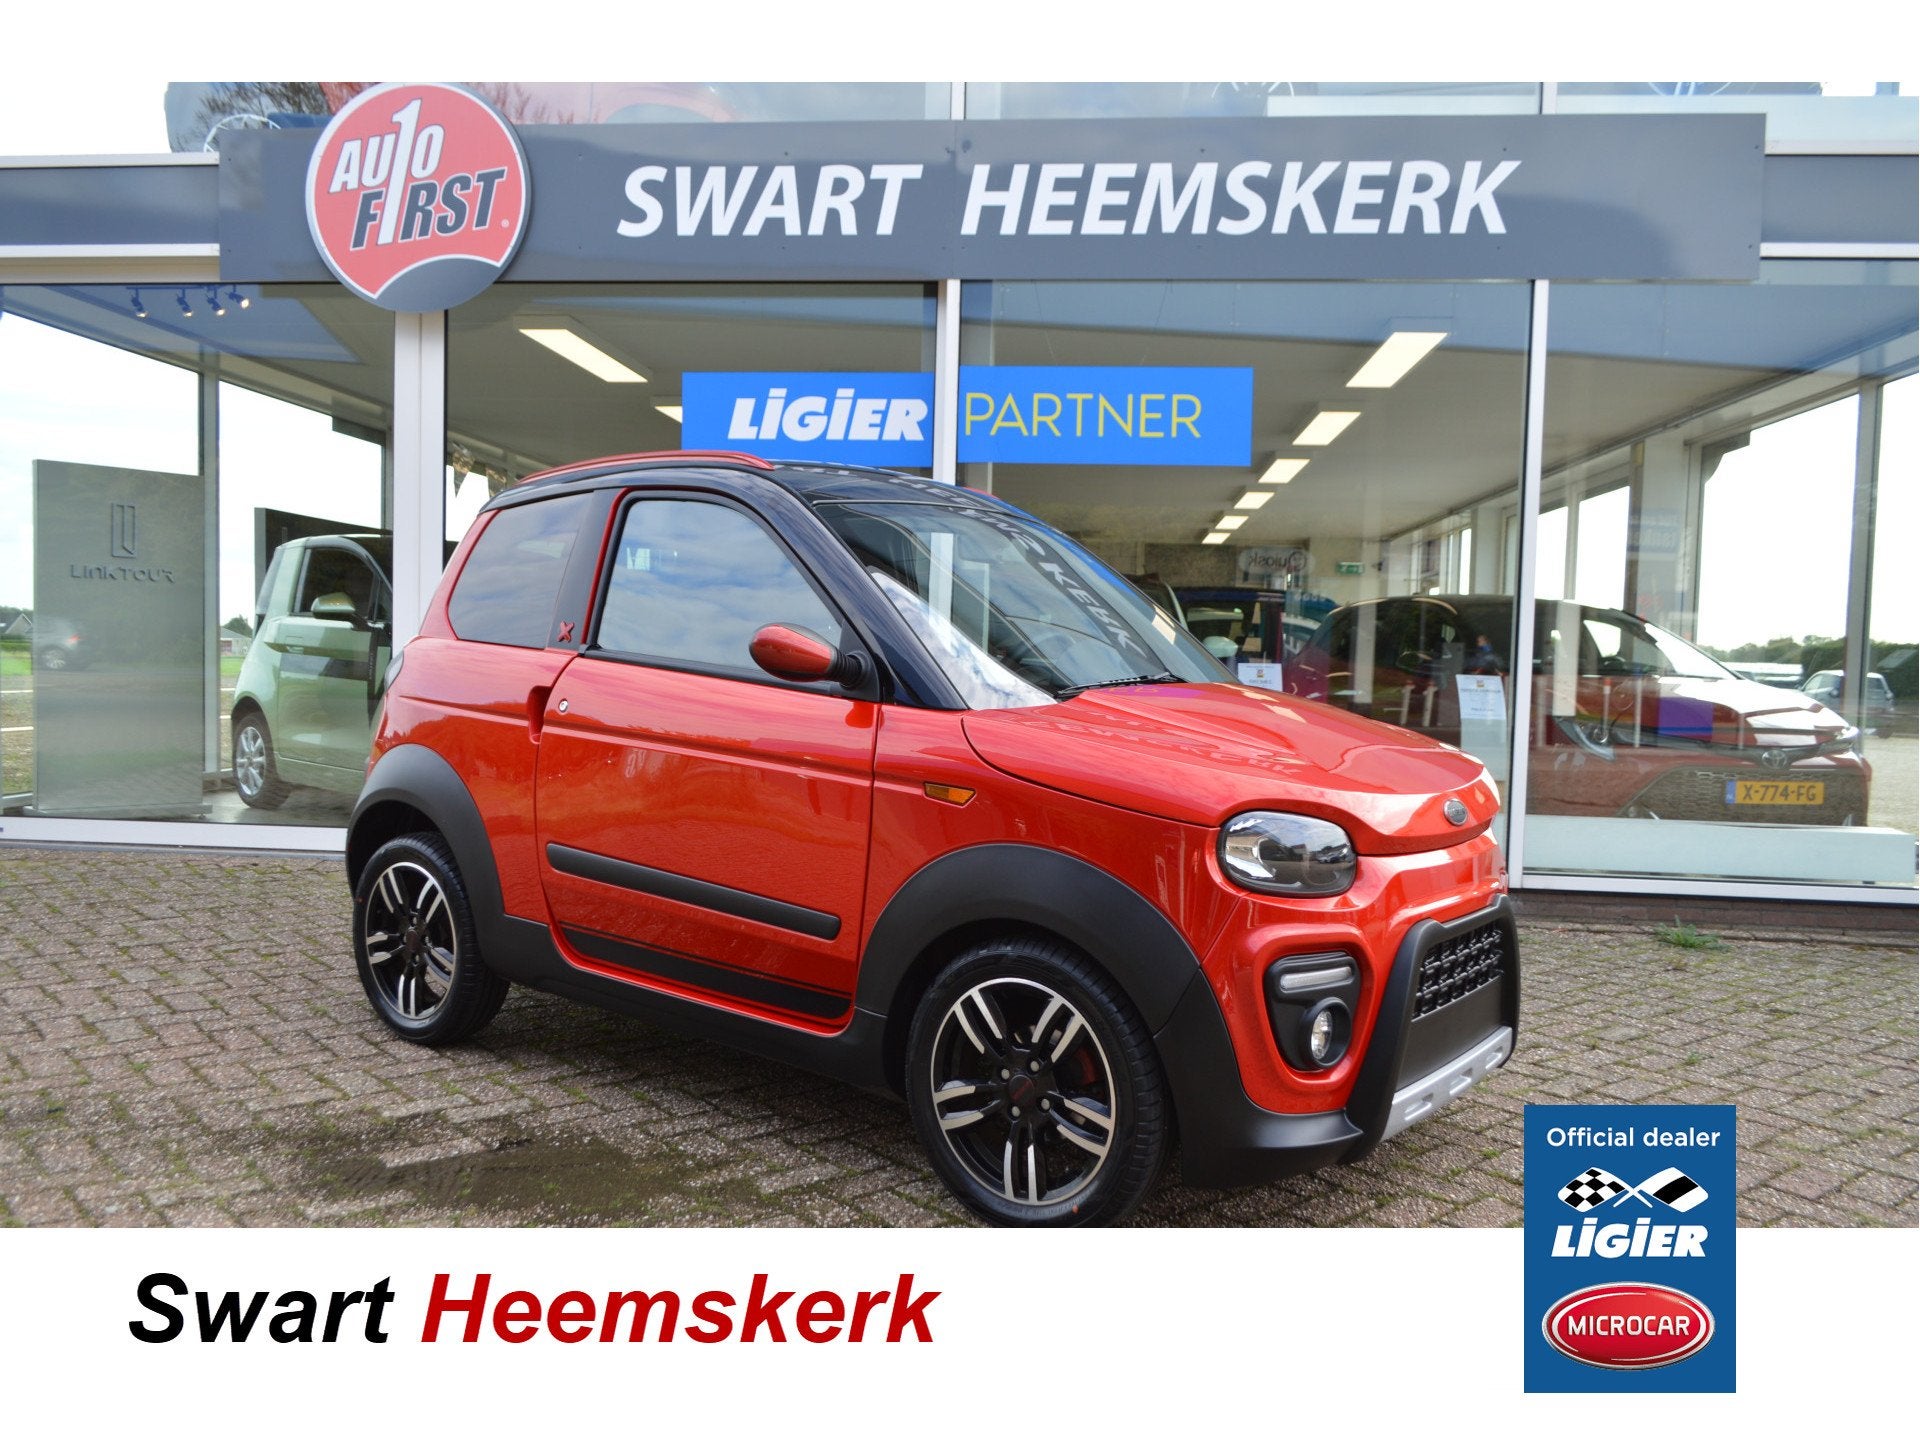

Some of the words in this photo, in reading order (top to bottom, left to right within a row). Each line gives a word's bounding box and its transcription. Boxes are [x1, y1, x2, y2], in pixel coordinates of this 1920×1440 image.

[616, 164, 924, 237] SWART
[960, 160, 1522, 236] HEEMSKERK
[965, 392, 1202, 438] PARTNER
[1742, 784, 1817, 802] X-774-FG
